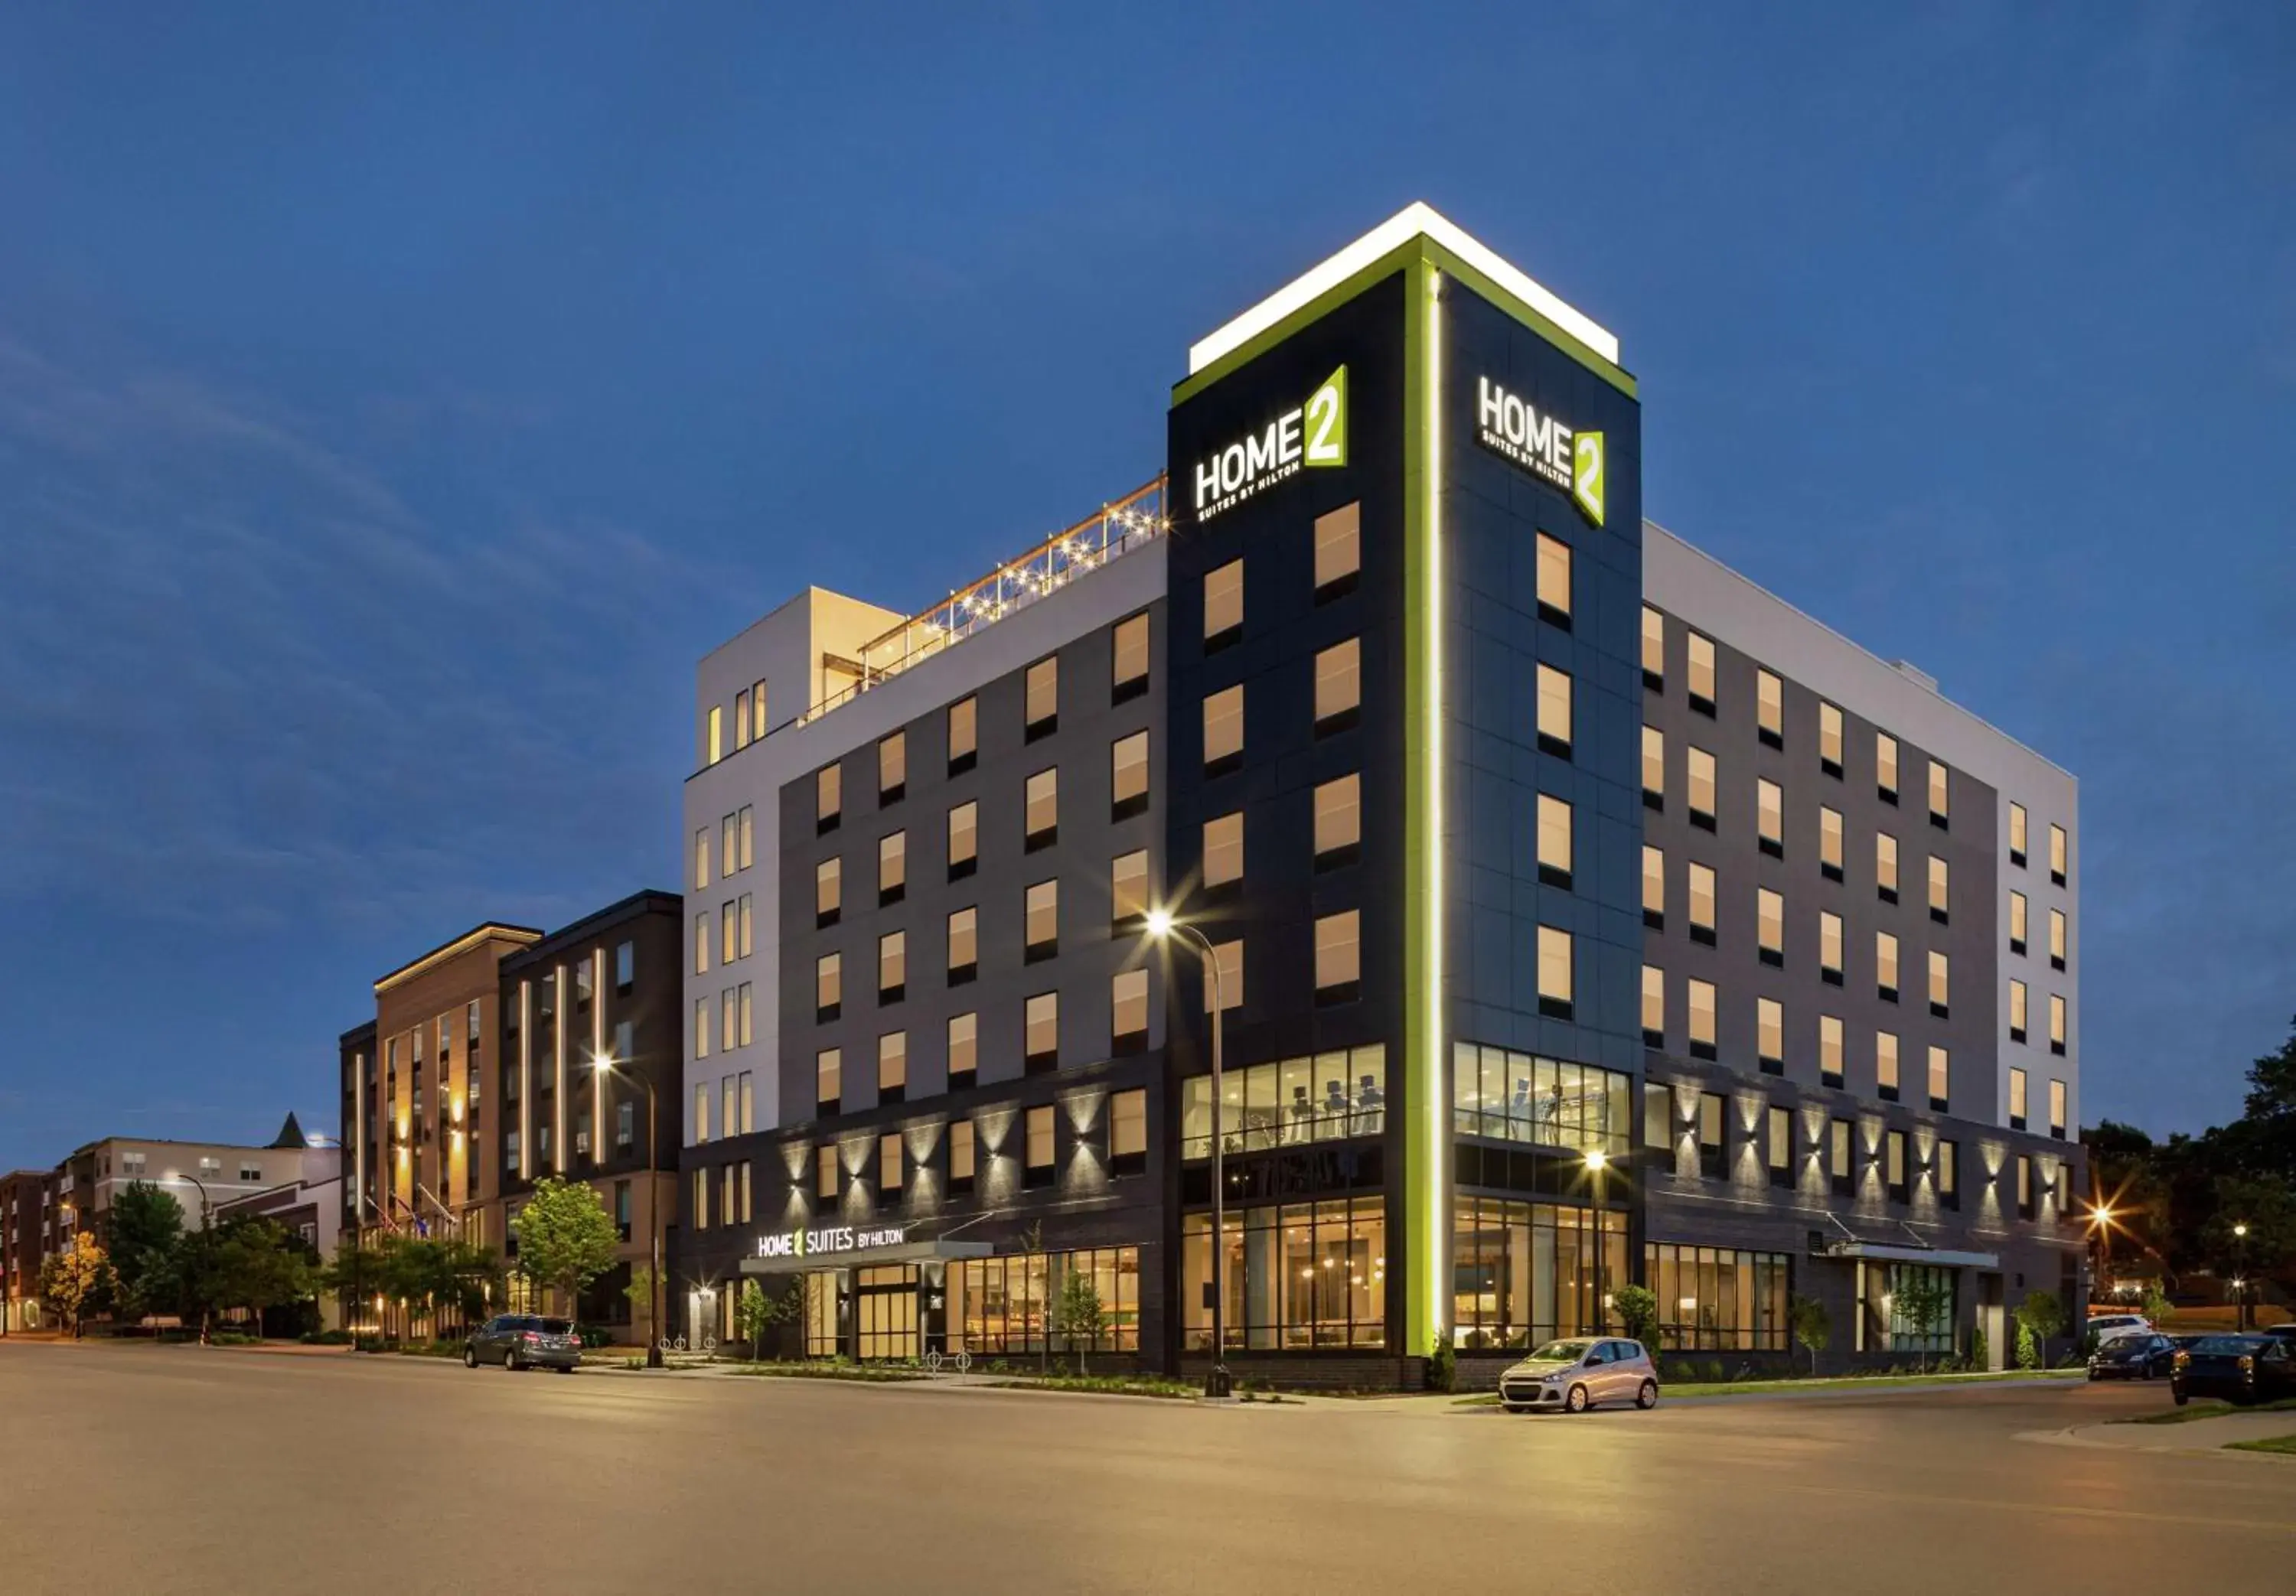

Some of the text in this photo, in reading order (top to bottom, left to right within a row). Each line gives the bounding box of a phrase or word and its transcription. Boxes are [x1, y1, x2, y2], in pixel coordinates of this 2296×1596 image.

[1482, 429, 1570, 489] SUITES BY HILTON
[1198, 460, 1300, 523] SUITES BY HILTON
[806, 1226, 853, 1253] SUITES
[858, 1233, 869, 1248] BY
[870, 1229, 904, 1247] HILTON
